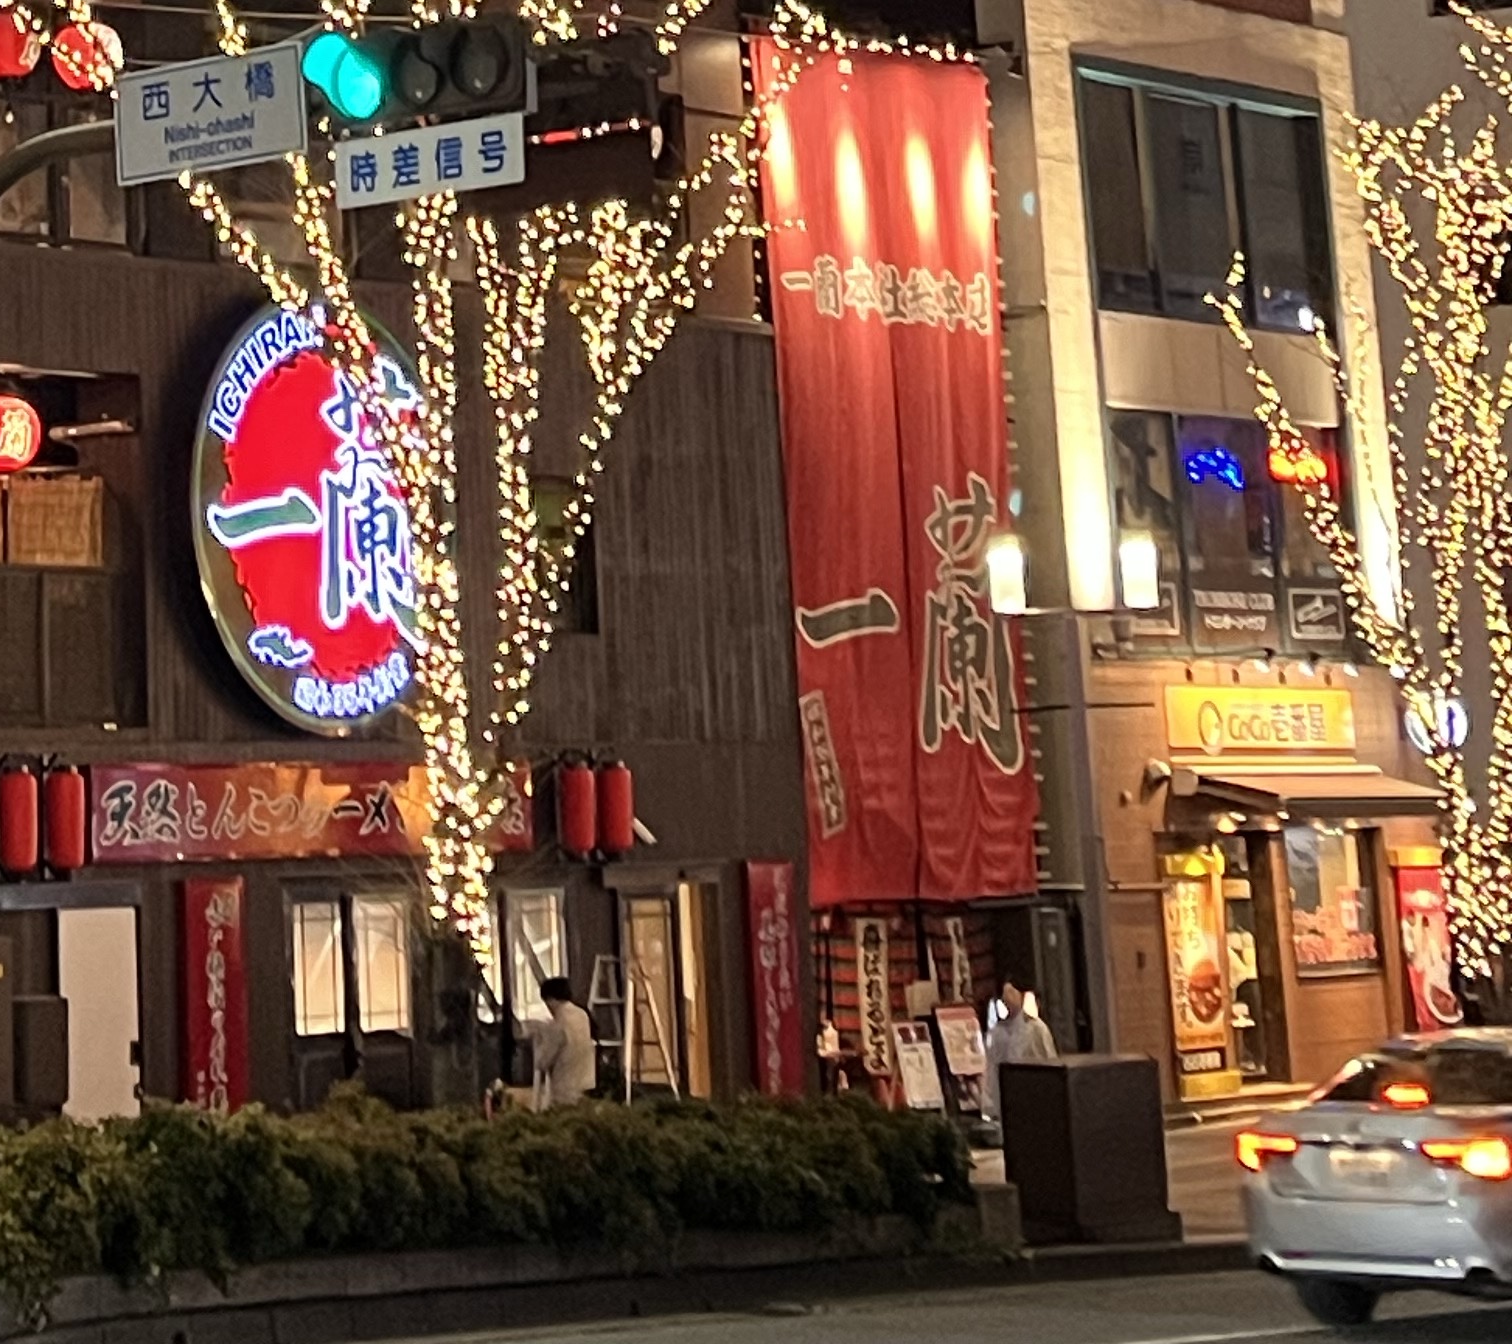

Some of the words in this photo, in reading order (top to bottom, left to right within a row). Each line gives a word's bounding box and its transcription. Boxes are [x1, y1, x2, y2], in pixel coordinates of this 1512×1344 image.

[141, 60, 276, 121] 西大橋
[164, 110, 255, 144] Nishi-ohashi
[168, 135, 253, 163] INTERSECTION
[347, 128, 508, 195] 時差信号
[795, 472, 1024, 776] 一蘭
